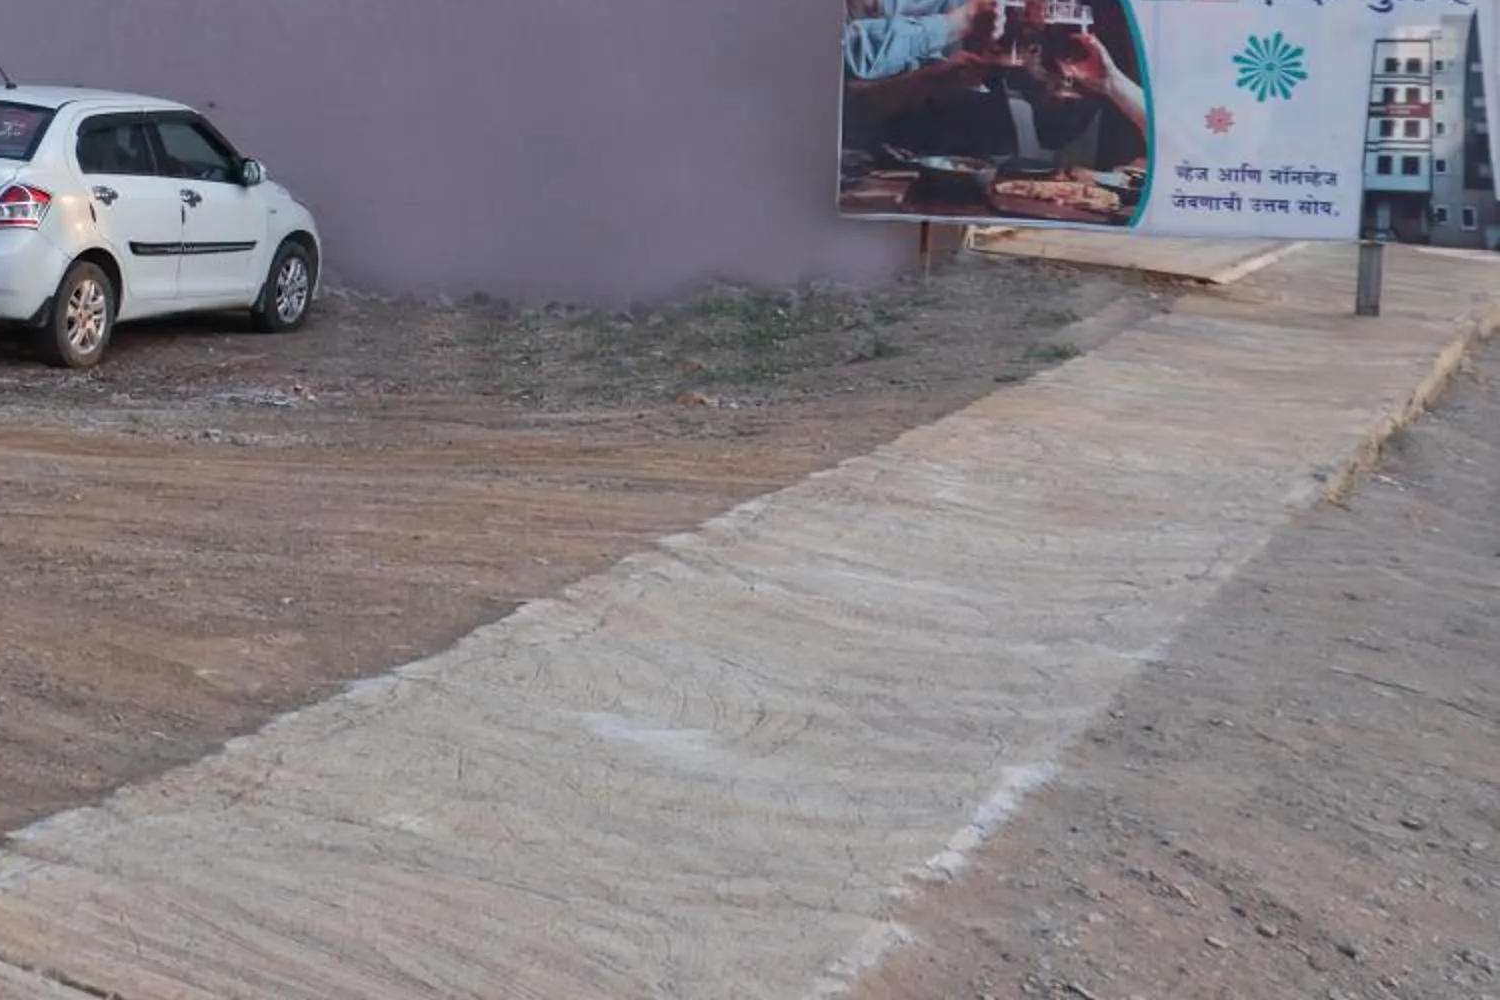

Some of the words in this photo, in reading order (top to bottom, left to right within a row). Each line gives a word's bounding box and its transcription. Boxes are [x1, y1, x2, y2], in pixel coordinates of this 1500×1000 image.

[1218, 162, 1262, 185] आणि
[1171, 187, 1243, 213] जेवणाची
[1248, 197, 1291, 215] उत्तम
